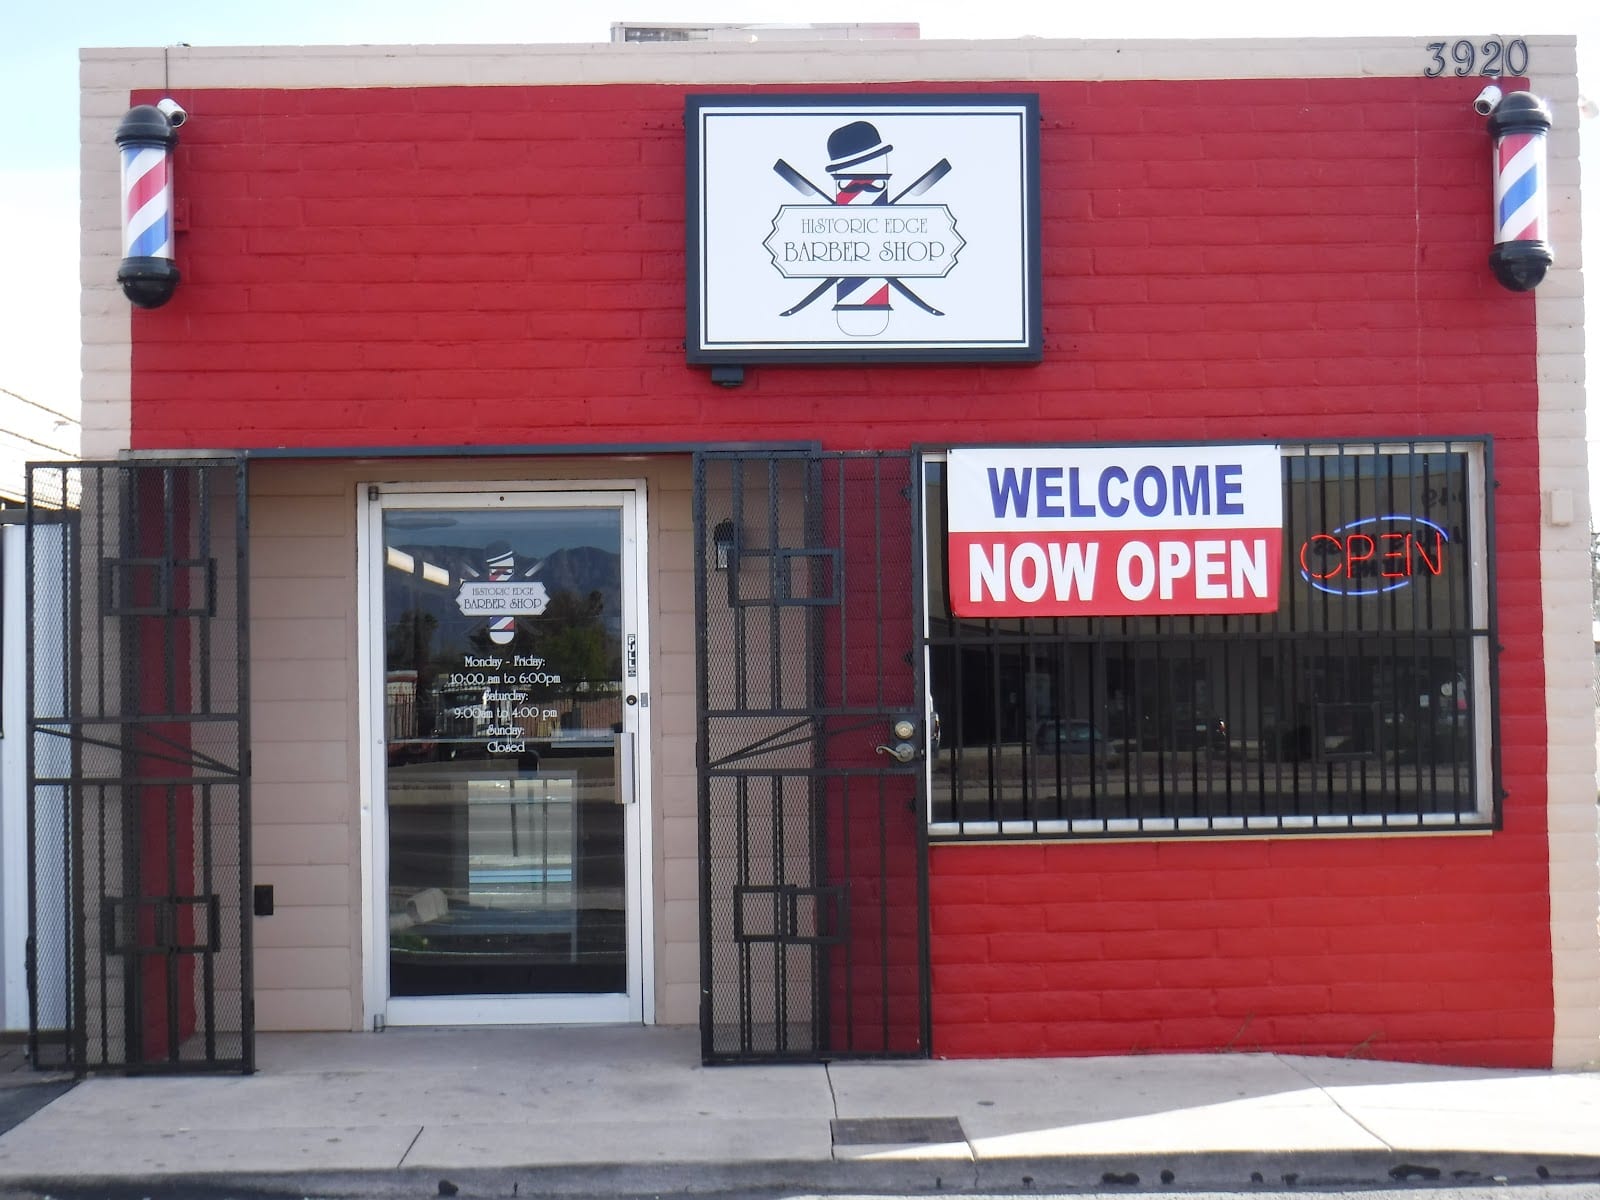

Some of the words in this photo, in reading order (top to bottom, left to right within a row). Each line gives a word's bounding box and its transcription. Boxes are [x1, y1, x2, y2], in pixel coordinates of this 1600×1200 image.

[1424, 39, 1528, 77] 3920
[801, 218, 879, 234] HISTORIC
[885, 218, 928, 234] EDGE
[784, 241, 871, 262] BARBER
[879, 241, 945, 262] SHOP
[987, 464, 1245, 518] WELCOME
[1300, 532, 1443, 580] OPEN
[969, 541, 1099, 602] NOW
[1116, 539, 1269, 601] OPEN
[472, 587, 510, 596] HISTORIC
[512, 587, 534, 596] EDGE
[464, 598, 506, 609] BARBER
[509, 598, 542, 609] SHOP
[628, 636, 636, 667] PULL
[464, 655, 503, 670] Monday
[514, 655, 546, 670] Friday:
[450, 673, 485, 684] 10:00
[487, 676, 500, 684] am
[503, 673, 516, 684] to
[519, 673, 561, 687] 6:00pm
[484, 689, 529, 705] Saturday:
[455, 707, 493, 719] 9:00am
[497, 707, 508, 718] to
[511, 707, 539, 718] 4:00
[542, 709, 558, 721] pm
[487, 724, 525, 739] Sunday:
[487, 741, 526, 753] Closed
